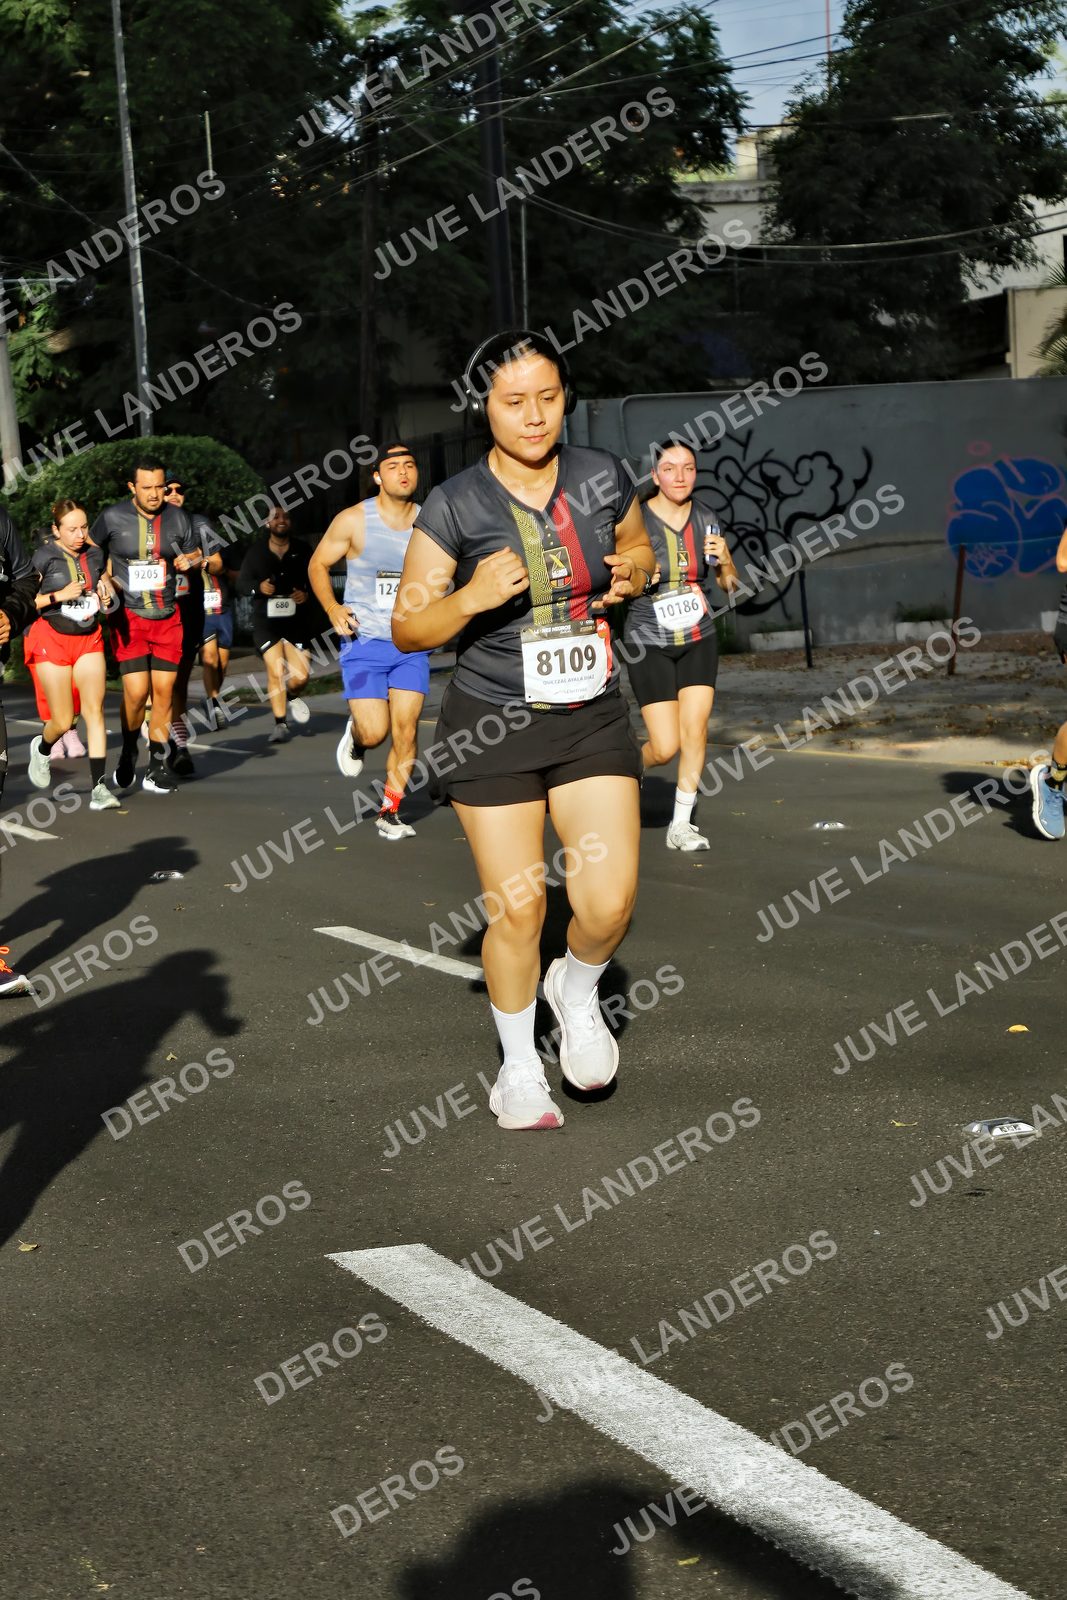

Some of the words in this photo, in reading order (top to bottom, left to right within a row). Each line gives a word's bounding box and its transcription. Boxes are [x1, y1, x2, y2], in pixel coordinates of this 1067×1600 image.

[134, 568, 158, 580] 9205
[275, 601, 290, 609] 680
[658, 598, 700, 619] 10186
[536, 644, 597, 676] 8109
